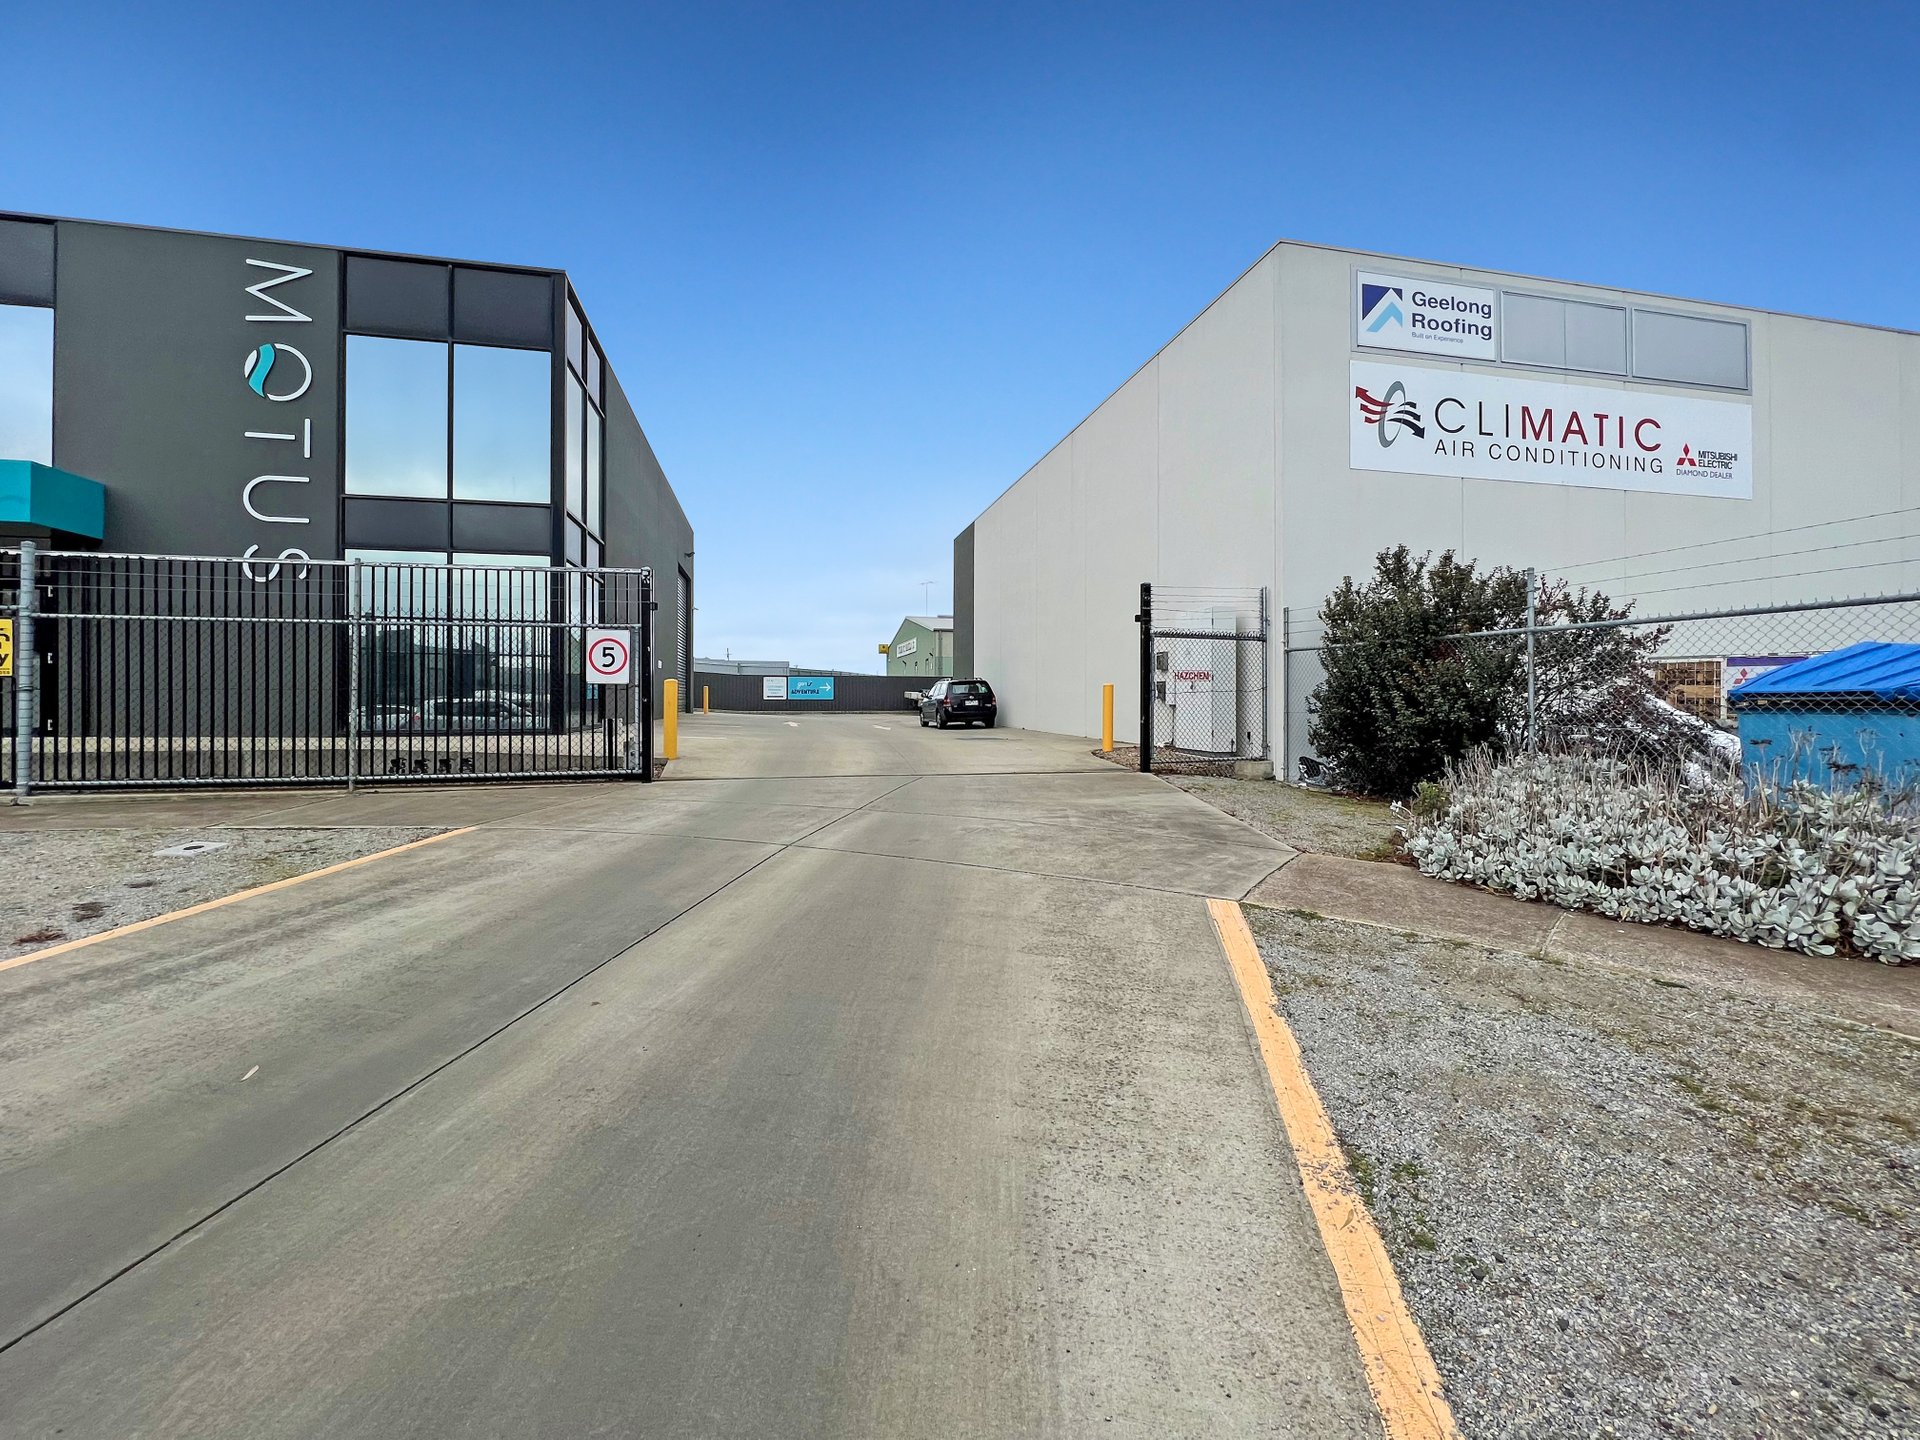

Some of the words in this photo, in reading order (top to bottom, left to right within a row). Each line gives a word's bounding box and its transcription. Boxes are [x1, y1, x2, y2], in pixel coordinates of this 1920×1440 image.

[1411, 291, 1492, 319] Geelong
[1411, 312, 1492, 341] Roofing
[1411, 331, 1424, 339] Built
[1433, 334, 1464, 344] Experience
[243, 257, 313, 583] MOTUS
[1435, 397, 1662, 452] CLIMATIC
[1434, 438, 1475, 458] AIR
[1488, 443, 1663, 474] CONDITIONING
[1698, 450, 1738, 461] MITSUBISHI
[1698, 459, 1733, 470] ELECTRIC
[1676, 468, 1709, 478] DIAMOND
[1709, 470, 1733, 480] DEALER
[602, 646, 616, 668] 5
